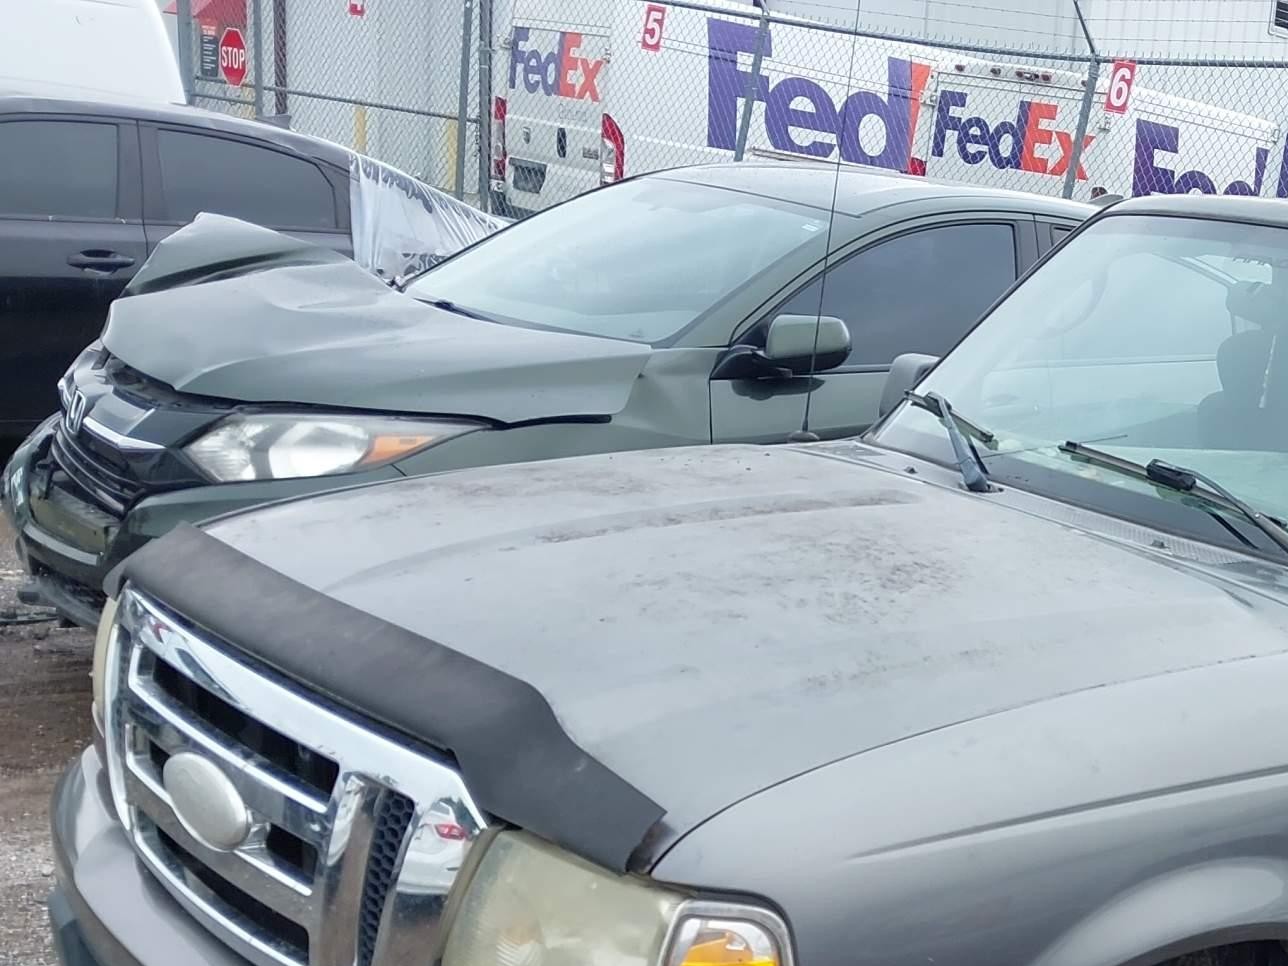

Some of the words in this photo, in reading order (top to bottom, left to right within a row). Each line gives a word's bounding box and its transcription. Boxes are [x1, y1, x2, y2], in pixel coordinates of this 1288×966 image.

[644, 11, 663, 46] 5
[221, 46, 245, 69] STOP
[509, 27, 603, 102] FedEx
[706, 17, 932, 171] Fed
[1109, 67, 1131, 107] 6
[931, 89, 1097, 181] FedEx
